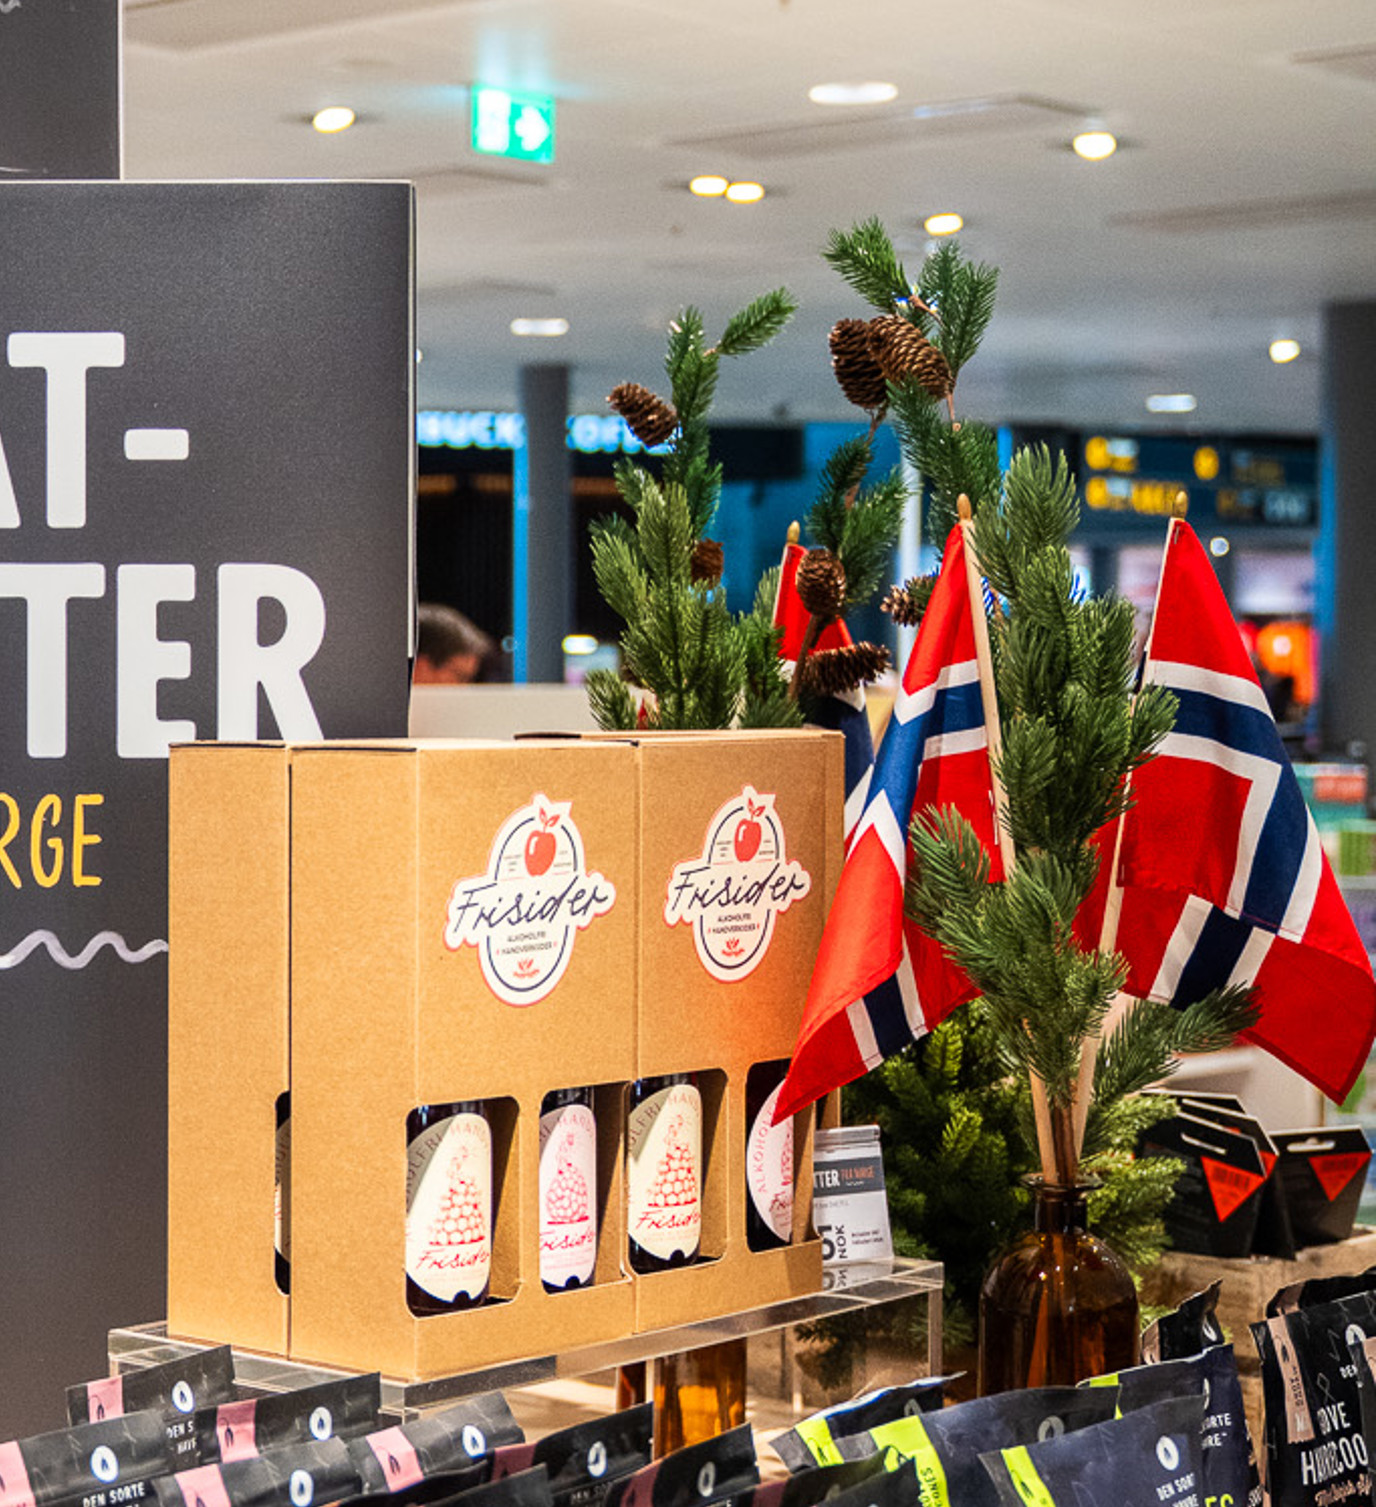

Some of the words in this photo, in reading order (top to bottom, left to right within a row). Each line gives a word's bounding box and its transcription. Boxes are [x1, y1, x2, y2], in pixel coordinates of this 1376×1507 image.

[454, 874, 609, 934] Frisider
[672, 862, 805, 911] Frisider
[835, 1225, 848, 1259] NOK
[82, 1489, 107, 1507] DEN
[108, 1481, 146, 1505] SORTE
